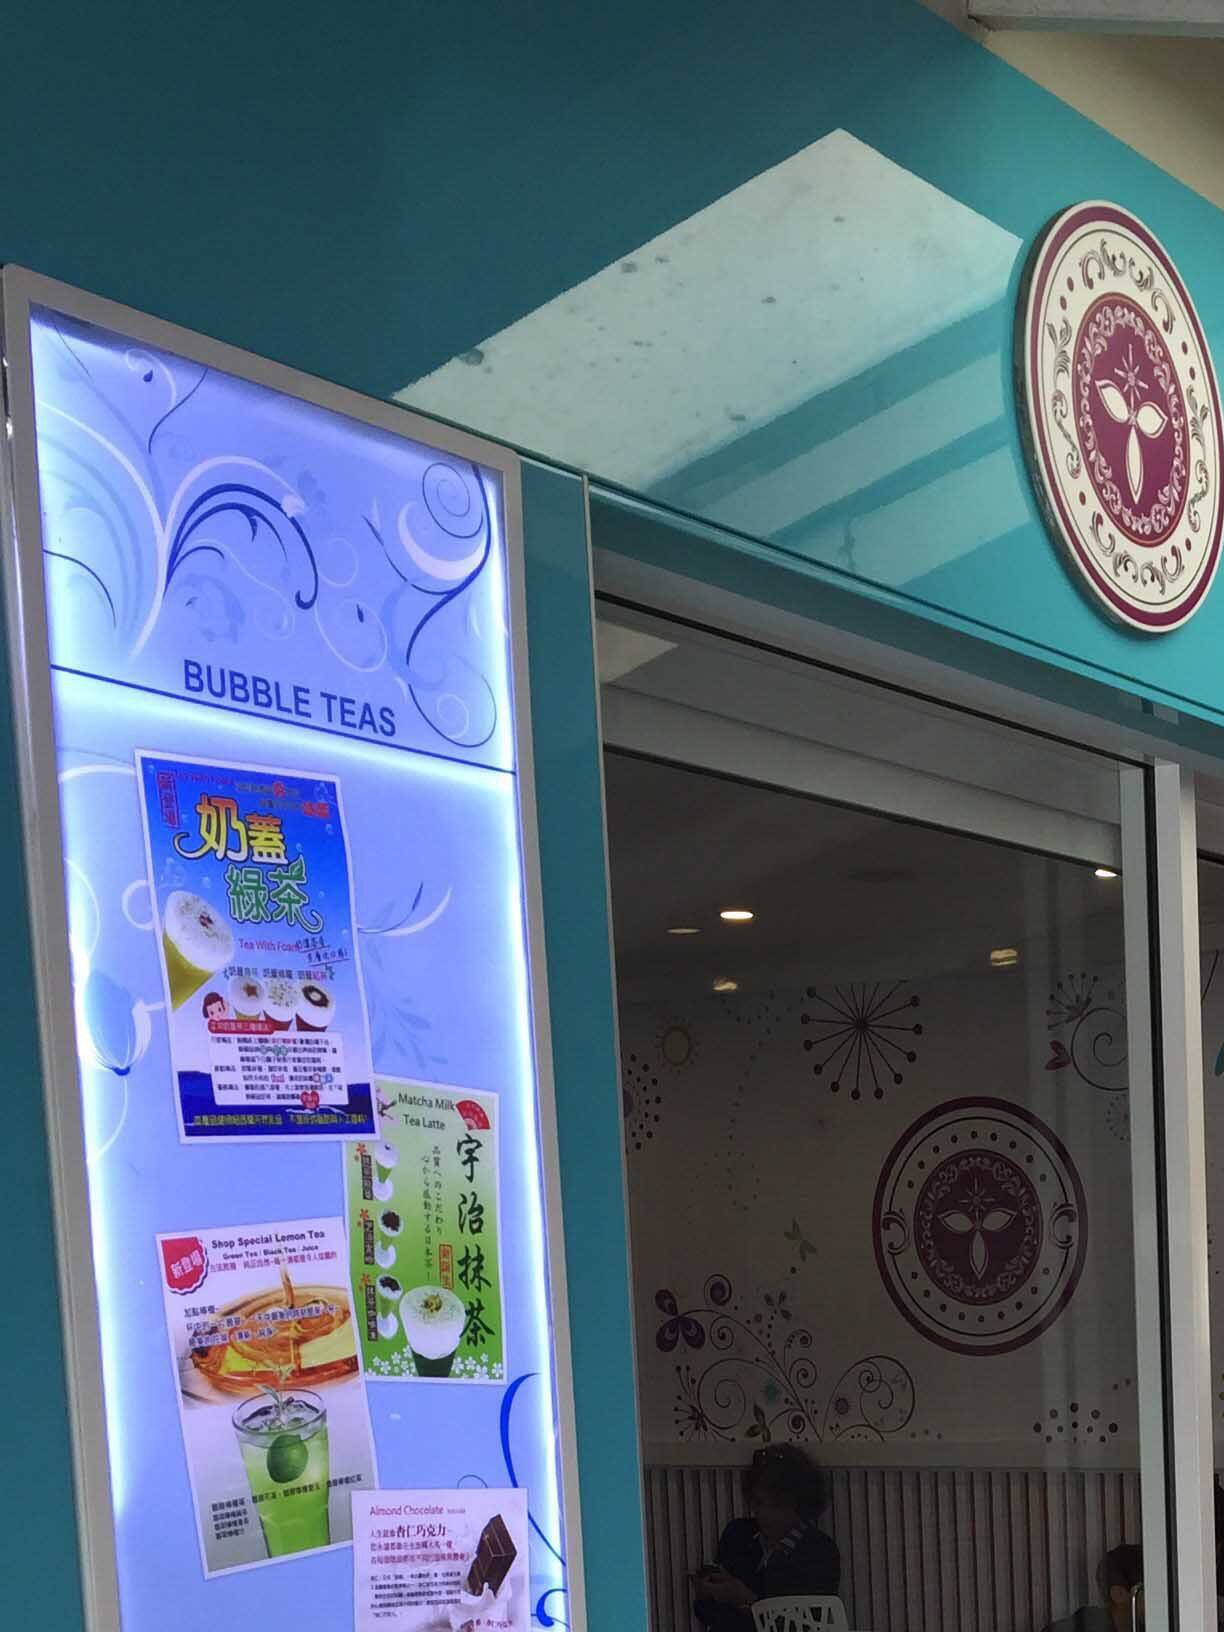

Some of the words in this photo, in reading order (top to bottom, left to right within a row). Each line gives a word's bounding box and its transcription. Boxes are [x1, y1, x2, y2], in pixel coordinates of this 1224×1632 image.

[183, 659, 312, 718] BUBBLE
[320, 691, 396, 737] TEAS
[398, 1092, 433, 1109] Matcha
[435, 1096, 455, 1111] Milk
[403, 1113, 418, 1127] Tea
[420, 1115, 446, 1131] Latte
[211, 1239, 235, 1250] Shop
[237, 1234, 273, 1248] Special
[275, 1231, 306, 1243] Lemon
[308, 1229, 325, 1240] Tea
[456, 1133, 495, 1347] 宇治抹茶
[369, 1505, 402, 1516] Almond
[403, 1504, 444, 1516] Chocolate
